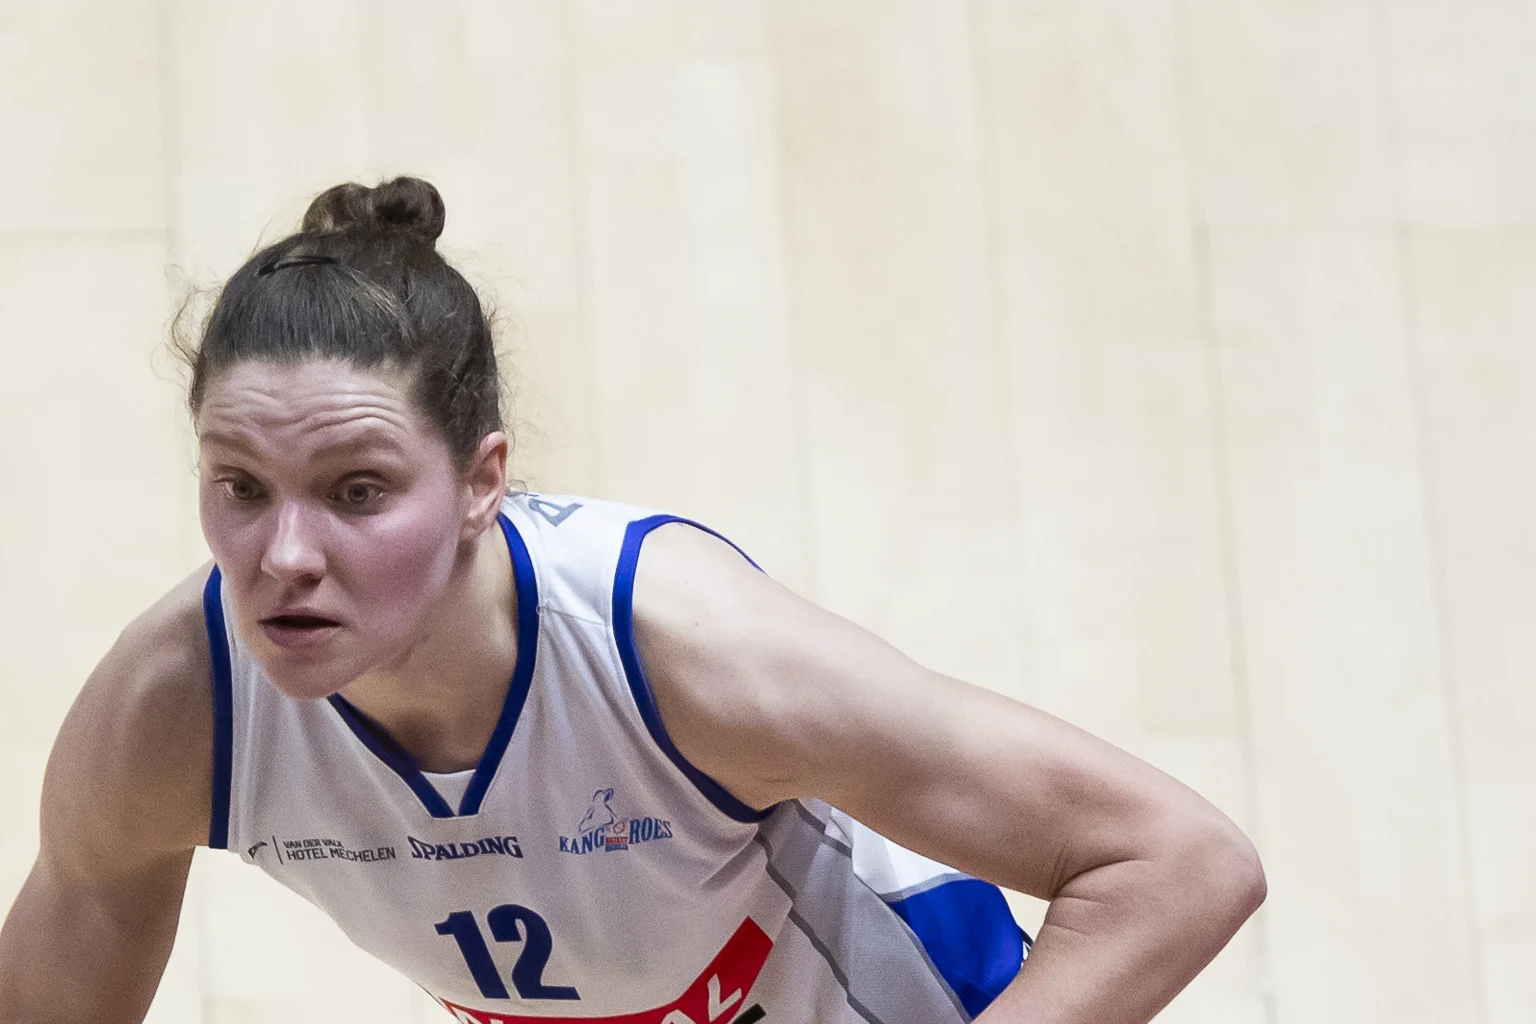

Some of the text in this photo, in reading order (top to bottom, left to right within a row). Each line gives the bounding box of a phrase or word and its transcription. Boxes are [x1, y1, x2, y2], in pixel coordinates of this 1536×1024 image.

[282, 839, 303, 849] VAN
[303, 838, 322, 848] DER
[407, 835, 524, 860] SPALDING
[286, 846, 396, 863] HOTEL MECHELEN
[434, 904, 581, 1000] 12
